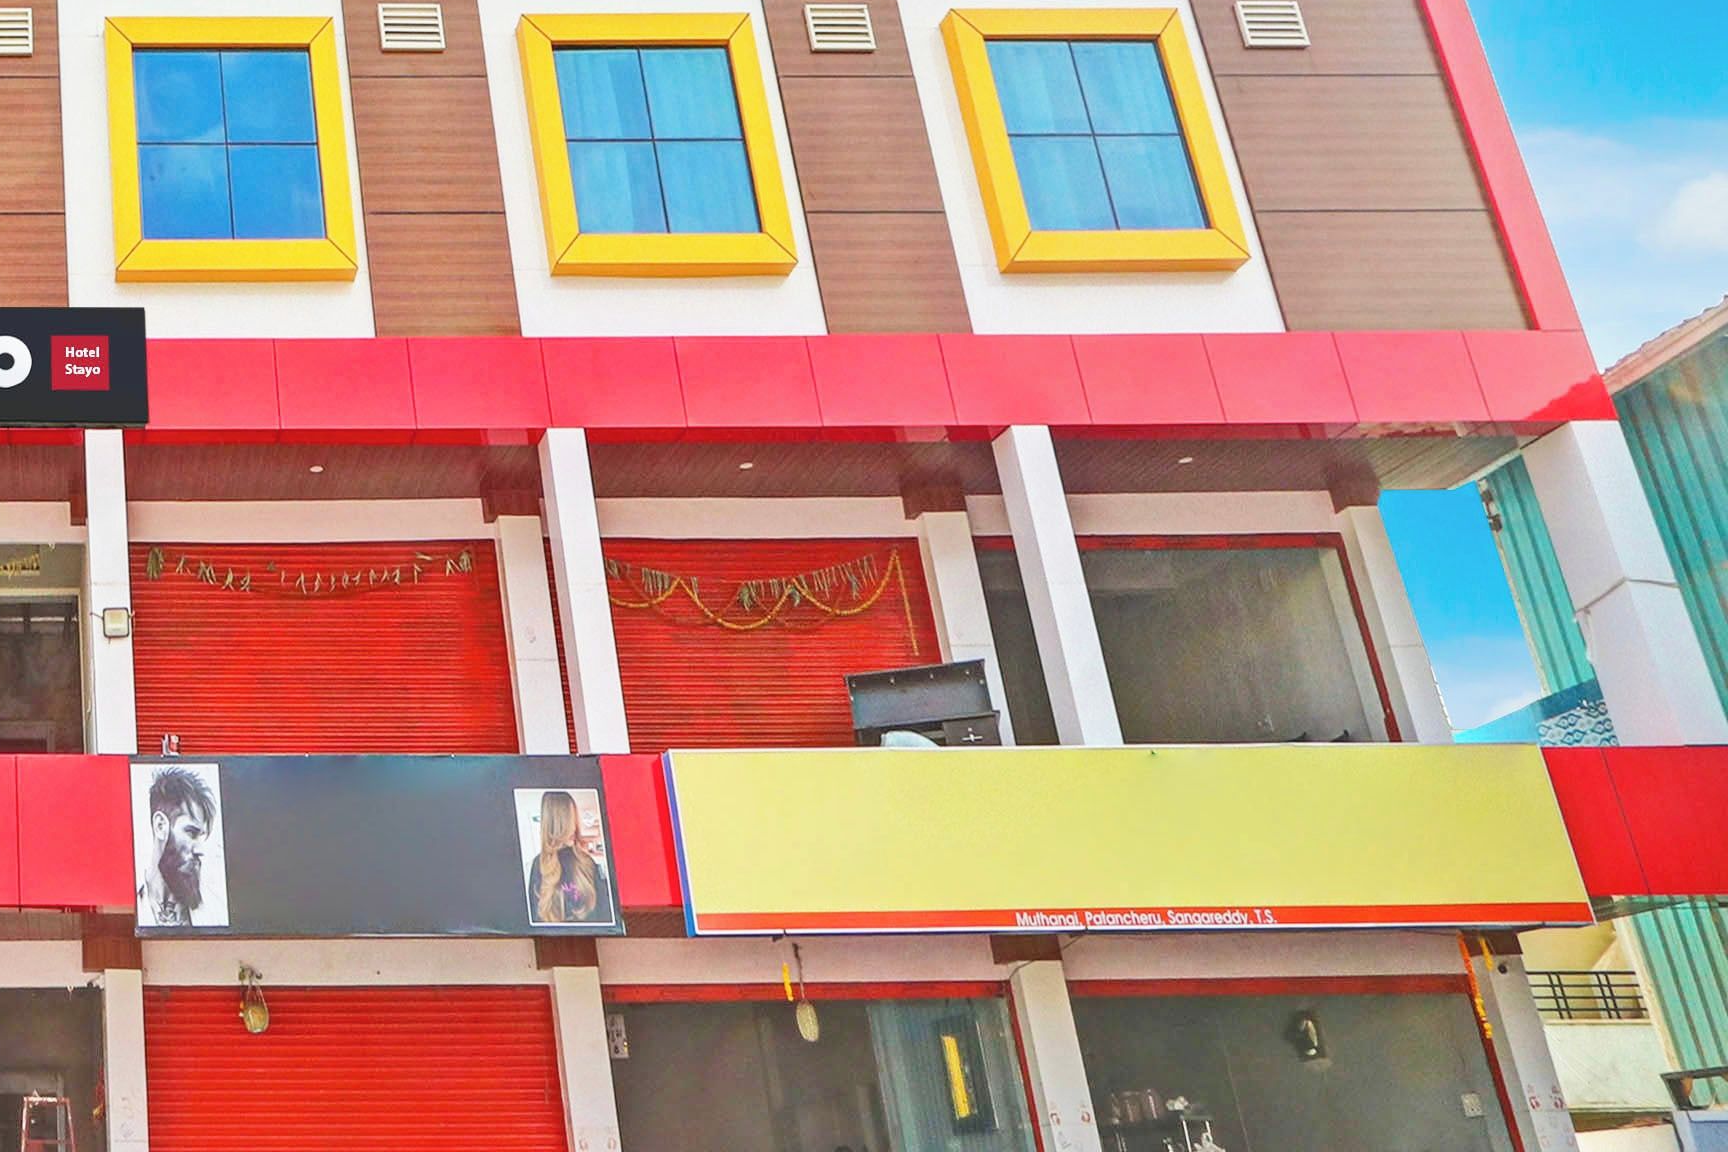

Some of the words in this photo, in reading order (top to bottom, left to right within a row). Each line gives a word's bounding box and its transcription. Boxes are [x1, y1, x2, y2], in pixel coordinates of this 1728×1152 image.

[64, 346, 100, 358] Hotel
[64, 363, 101, 378] Stayo
[1084, 910, 1166, 926] Patancheru,
[1253, 908, 1279, 924] T.S.
